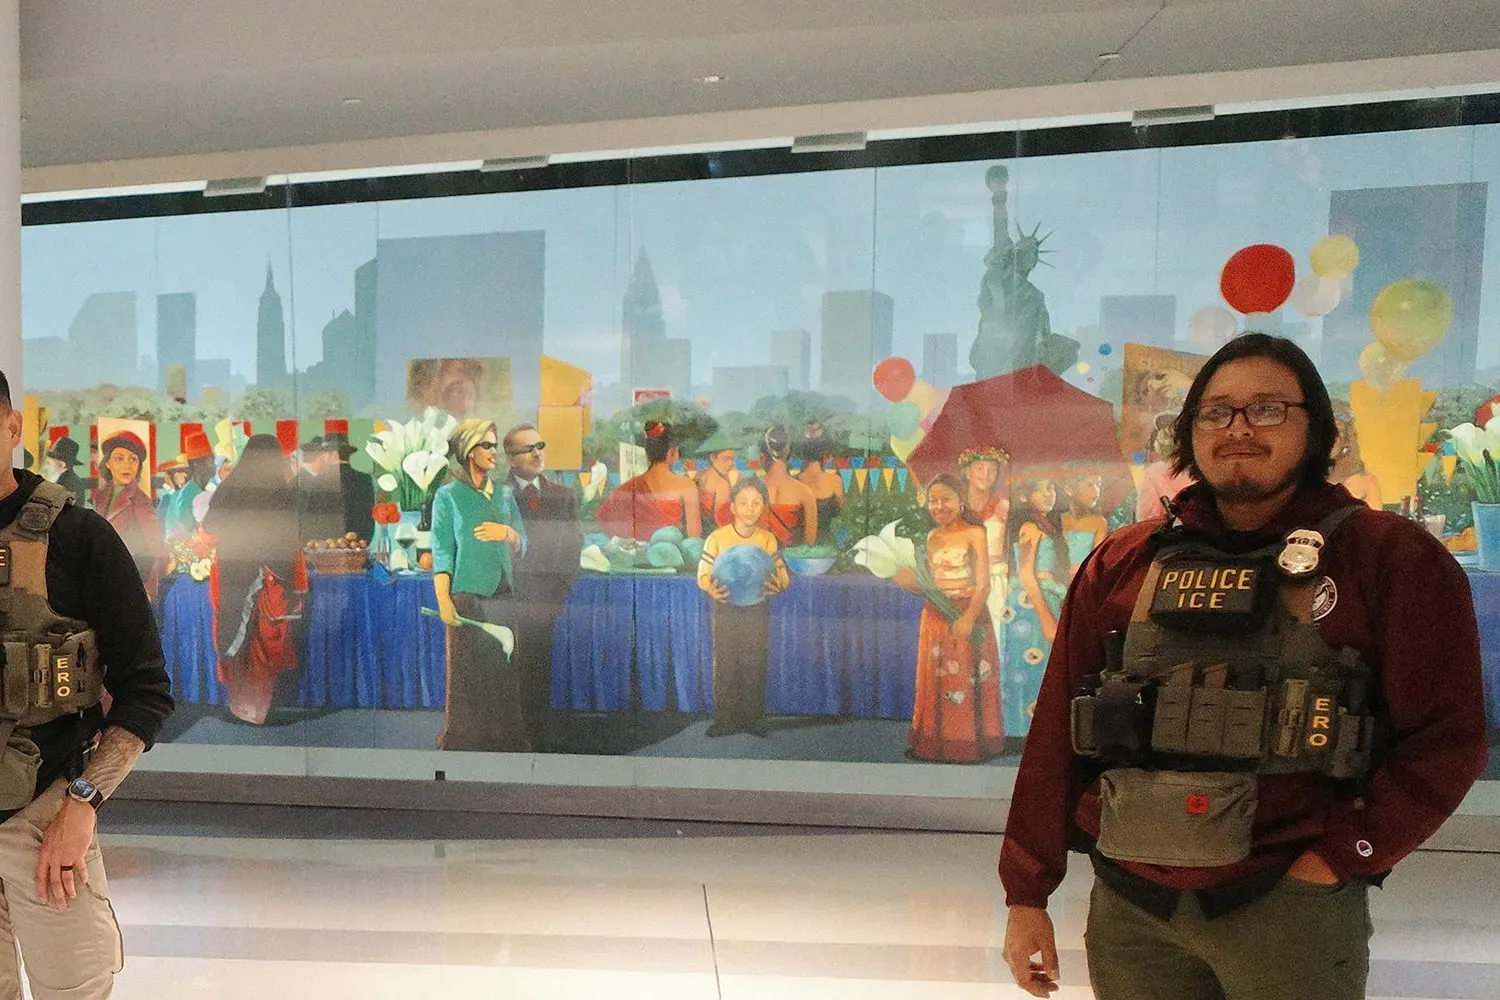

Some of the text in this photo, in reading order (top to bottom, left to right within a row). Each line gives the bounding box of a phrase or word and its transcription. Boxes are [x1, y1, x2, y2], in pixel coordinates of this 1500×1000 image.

[1162, 568, 1254, 590] POLICE
[1177, 592, 1227, 609] ICE
[56, 657, 71, 697] ERO
[1309, 697, 1331, 746] ERO
